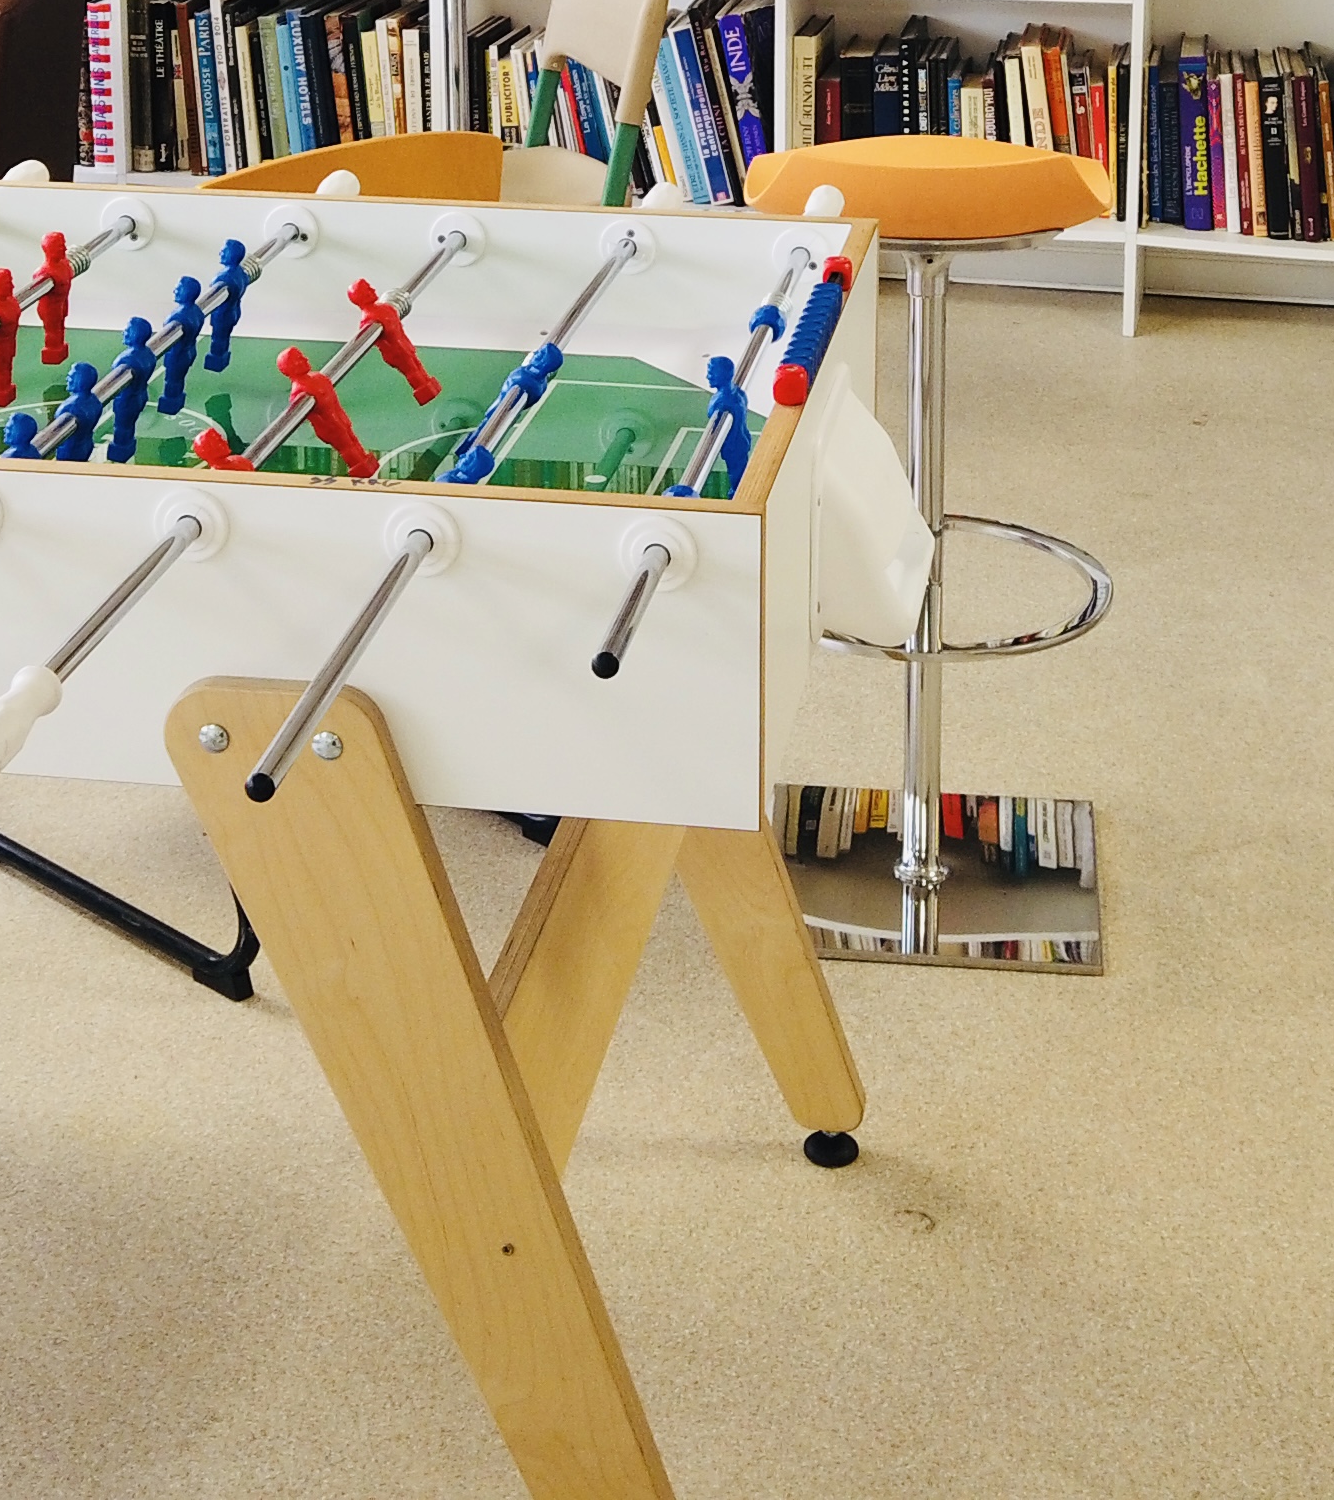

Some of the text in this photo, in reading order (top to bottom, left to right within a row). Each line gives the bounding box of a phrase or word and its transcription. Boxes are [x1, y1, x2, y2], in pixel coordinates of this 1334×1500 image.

[198, 19, 214, 118] LAROUSSE PARIS
[290, 20, 306, 72] LUXURY
[724, 26, 746, 72] INDE
[803, 57, 813, 70] LE
[156, 67, 165, 78] LE
[503, 71, 513, 123] PUBLICITOR
[802, 75, 813, 119] MONDE
[220, 96, 231, 146] PORTRAITS
[1193, 116, 1208, 196] Hachette
